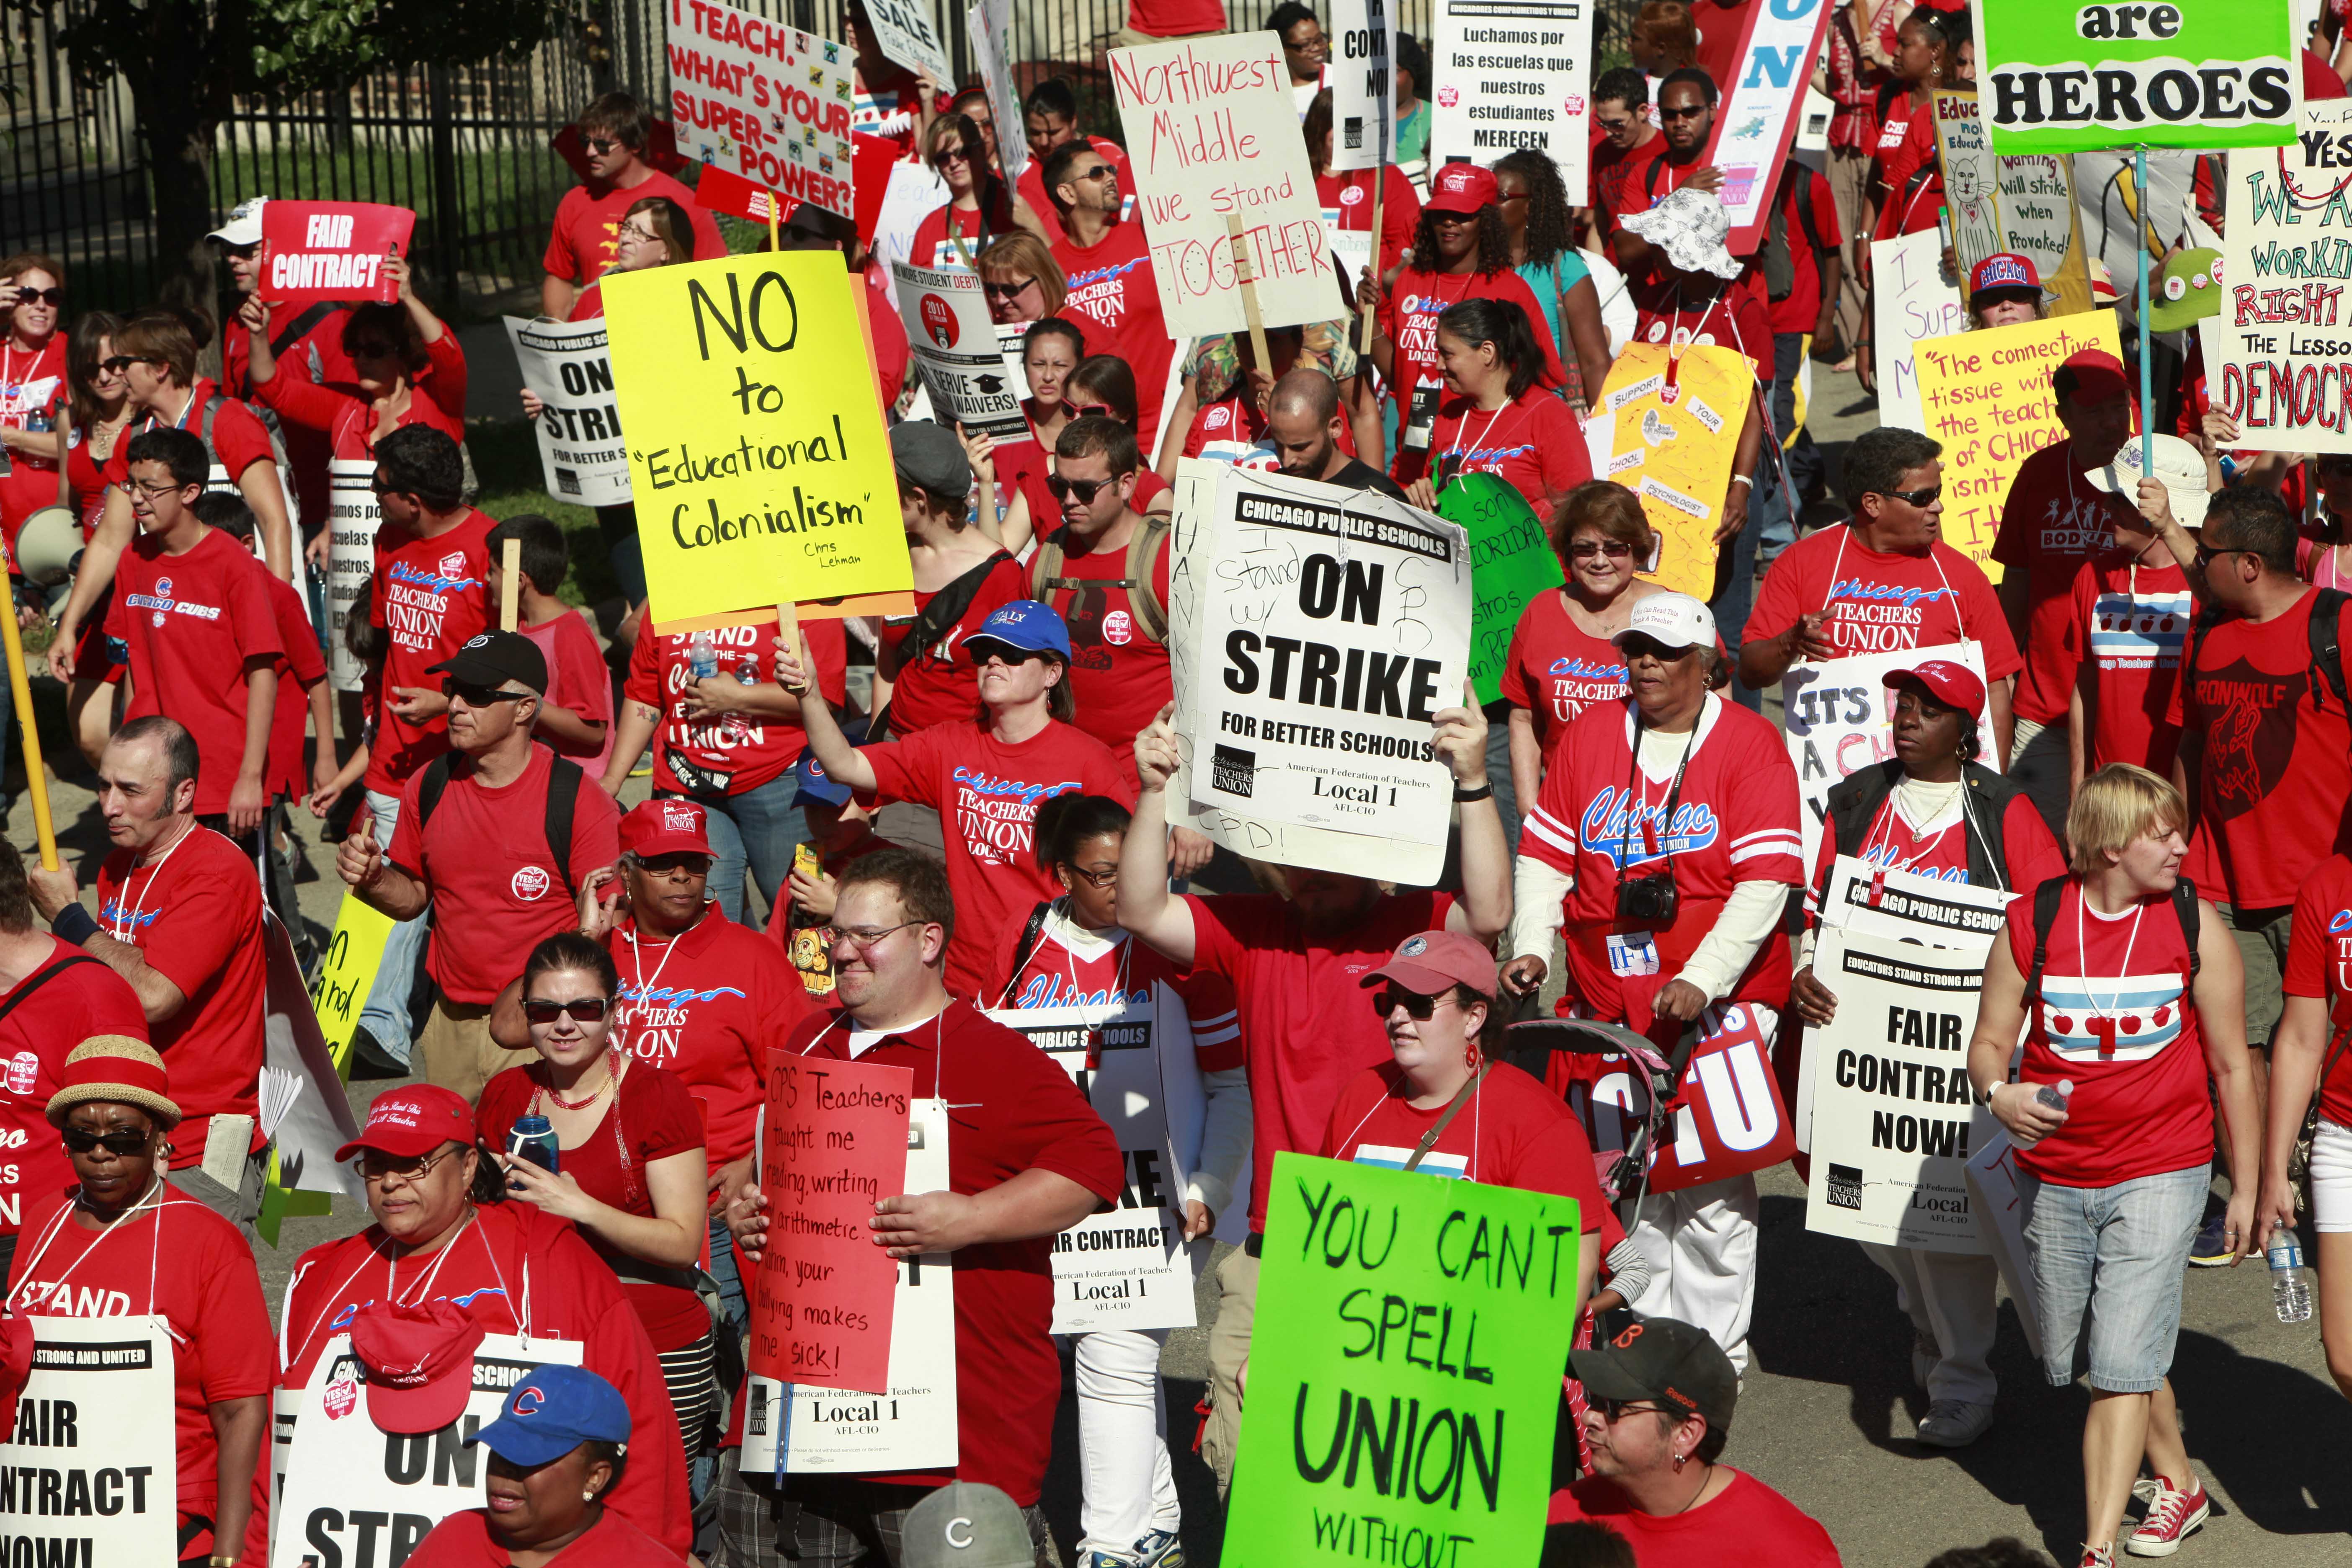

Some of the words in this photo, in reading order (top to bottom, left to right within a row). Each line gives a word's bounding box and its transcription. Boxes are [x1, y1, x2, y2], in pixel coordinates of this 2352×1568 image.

[1451, 4, 1492, 14] EDUCADORES
[1493, 6, 1546, 15] COMPROMETIDOS
[2081, 5, 2179, 39] are
[690, 0, 794, 66] TEACH.
[1464, 27, 1537, 44] Luchamos
[1541, 30, 1564, 46] por
[1110, 44, 1281, 108] Northwest
[1453, 53, 1474, 67] las
[1478, 54, 1544, 70] escuelas
[1547, 57, 1573, 72] que
[669, 45, 770, 108] WHAT'S
[774, 80, 851, 141] YOUR
[1481, 79, 1545, 95] nuestros
[1990, 67, 2293, 124] HEROES
[672, 90, 777, 151] SUPER-
[1469, 105, 1554, 121] estudiantes
[1150, 107, 1260, 175] Middle
[1474, 129, 1549, 149] MERECEN
[2299, 131, 2352, 168] YES
[740, 144, 852, 213] POWER?
[1999, 178, 2027, 198] Will
[2030, 176, 2067, 197] strike
[1147, 193, 1191, 225] we
[1210, 171, 1293, 212] stand
[2246, 170, 2303, 227] WE
[306, 214, 354, 248] FAIR
[2008, 230, 2070, 255] Provoked!
[272, 253, 382, 289] CONTRACT
[1152, 220, 1331, 304] TOGETHER
[1980, 262, 2027, 289] CHICAGO
[901, 268, 918, 281] MORE
[919, 271, 951, 288] STUDENT
[954, 275, 981, 289] DEBT!
[687, 270, 798, 361] NO
[926, 300, 946, 316] 2011
[2233, 283, 2344, 327] RIGHT
[520, 333, 556, 350] CHICAGO
[556, 334, 590, 351] PUBLIC
[2241, 334, 2277, 354] THE
[560, 358, 614, 397] ON
[732, 366, 783, 415] to
[955, 393, 1019, 415] WAIVERS!
[1614, 377, 1659, 407] SUPPORT
[1928, 384, 2001, 409] tissue
[1002, 422, 1026, 431] CONTRACT
[1694, 405, 1721, 428] YOUR
[1936, 413, 1978, 439] the
[552, 449, 571, 462] FOR
[574, 449, 617, 464] BETTER
[1956, 441, 1982, 468] of
[1475, 492, 1509, 520] son
[1646, 482, 1703, 512] PSYCHOLOGIST
[1241, 500, 1315, 527] CHICAGO
[1318, 513, 1373, 538] PUBLIC
[1377, 527, 1446, 556] SCHOOLS
[805, 542, 837, 557] Chris
[819, 556, 861, 569] Lehman
[389, 560, 482, 595] Chicago
[1298, 553, 1385, 626] ON
[126, 593, 174, 611] CHICAGO
[175, 601, 221, 621] CUBS
[389, 584, 448, 614] TEACHERS
[386, 603, 444, 638] UNION
[989, 611, 1026, 623] ITALY
[1107, 619, 1120, 628] YES
[1651, 616, 1673, 626] Teacher
[1835, 602, 1922, 624] TEACHERS
[393, 630, 425, 648] LOCAL
[672, 626, 757, 646] STAND
[1833, 622, 1920, 650] UNION
[716, 650, 735, 660] THE
[2118, 658, 2157, 668] Teachers
[1223, 629, 1442, 724] STRIKE
[1800, 686, 1872, 727] IT'S
[669, 721, 765, 749] UNION
[1221, 711, 1256, 736] FOR
[1261, 722, 1335, 749] BETTER
[1339, 730, 1434, 763] SCHOOLS
[953, 766, 1082, 805] Chicago
[1213, 774, 1252, 795] UNION
[1214, 765, 1253, 782] TEACHERS
[1285, 761, 1328, 779] American
[1330, 767, 1377, 782] Federation
[1380, 774, 1390, 784] of
[1392, 775, 1431, 789] Teachers
[958, 787, 1039, 822] TEACHERS
[1313, 776, 1379, 805] Local
[1387, 786, 1398, 807] 1
[1332, 803, 1376, 816] AFL-CIO
[667, 820, 694, 830] UNION
[957, 808, 1033, 852] UNION
[1665, 838, 1690, 851] UNION
[518, 874, 533, 883] YES
[1908, 903, 1961, 927] PUBLIC
[1607, 940, 1654, 971] IFT
[1847, 956, 1893, 977] EDUCATORS
[1895, 965, 1924, 983] STAND
[1924, 971, 1962, 987] STRONG
[1963, 974, 1983, 987] AND
[1027, 1031, 1079, 1049] PUBLIC
[1887, 1005, 1963, 1052] FAIR
[9, 1061, 26, 1073] YES
[807, 1071, 907, 1114] Teachers
[387, 1113, 417, 1127] Teacher
[389, 1101, 407, 1113] Read
[407, 1104, 421, 1115] This
[772, 1125, 815, 1152] taught
[826, 1128, 855, 1151] me
[1872, 1110, 1970, 1158] NOW!
[811, 1171, 878, 1205] writing
[1887, 1178, 1923, 1191] American
[1827, 1190, 1862, 1209] UNION
[1910, 1189, 1969, 1214] Local
[1929, 1212, 1968, 1225] AFL-CIO
[1077, 1226, 1171, 1253] CONTRACT
[1296, 1176, 1398, 1270] YOU
[1437, 1204, 1573, 1298] CAN'T
[795, 1259, 835, 1288] your
[1086, 1267, 1126, 1279] Federation
[1138, 1265, 1173, 1276] Teachers
[21, 1281, 130, 1318] STAND
[1073, 1279, 1130, 1301] Local
[1137, 1278, 1148, 1298] 1
[804, 1303, 869, 1331] makes
[1093, 1301, 1131, 1311] AFL-CIO
[1339, 1288, 1493, 1385] SPELL
[36, 1349, 75, 1364] STRONG
[76, 1350, 100, 1364] AND
[102, 1349, 146, 1363] UNITED
[759, 1331, 778, 1359] me
[791, 1341, 840, 1376] sick!
[325, 1387, 342, 1401] YES
[512, 1386, 545, 1416] C
[1664, 1386, 1697, 1411] Reebok
[812, 1399, 879, 1424] Local
[889, 1398, 901, 1421] 1
[833, 1425, 879, 1436] AFL-CIO
[1293, 1380, 1505, 1513] UNION
[945, 1516, 974, 1549] C
[1313, 1506, 1474, 1568] WITHOUT
[1104, 1558, 1117, 1566] NIKE
